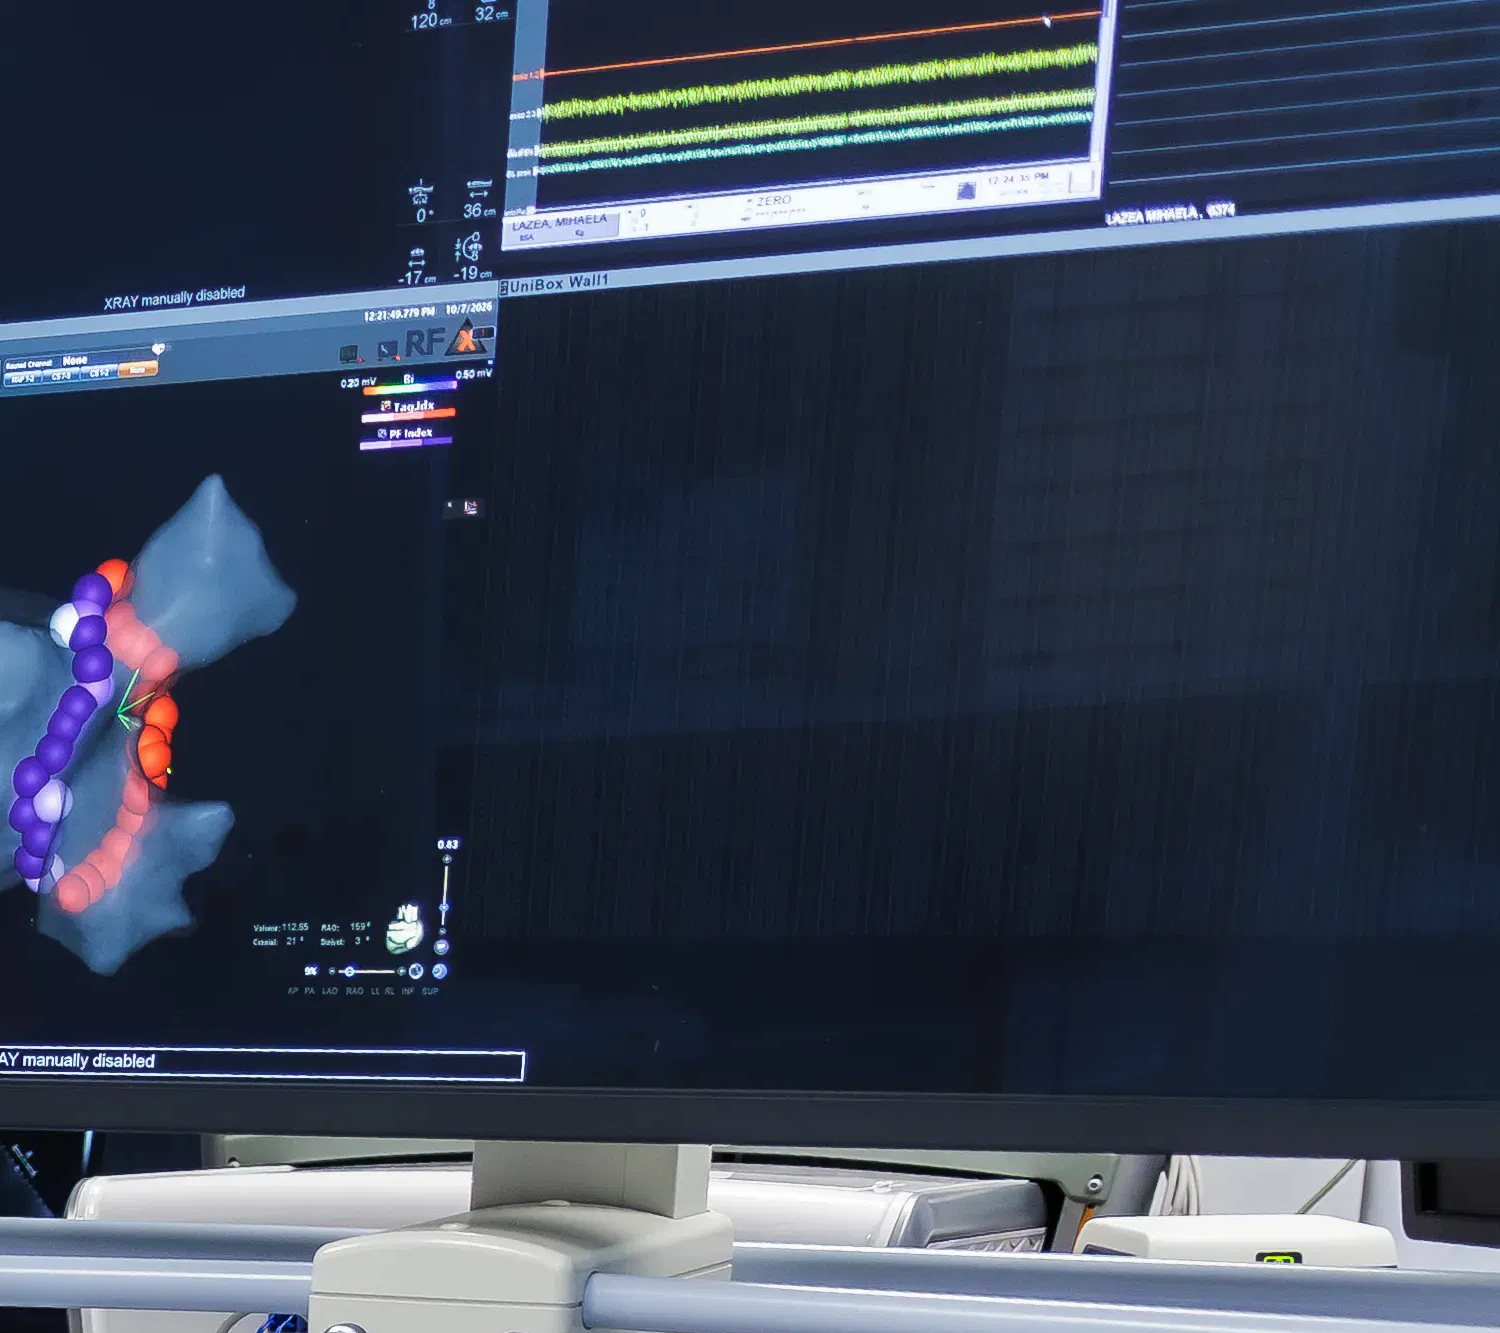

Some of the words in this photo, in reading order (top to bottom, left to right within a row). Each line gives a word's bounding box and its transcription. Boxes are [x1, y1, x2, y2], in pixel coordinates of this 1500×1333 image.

[411, 12, 438, 30] 120
[439, 18, 453, 26] cm
[475, 6, 494, 21] 32
[495, 11, 509, 20] cm
[757, 195, 792, 206] ZERO
[463, 203, 482, 218] 36
[484, 208, 497, 216] cm
[512, 219, 552, 231] LAZEA,
[555, 213, 608, 227] MIHAELA
[398, 271, 422, 285] -17
[453, 266, 478, 281] -19
[479, 271, 492, 279] cm
[510, 277, 563, 294] UniBox
[569, 273, 609, 289] Wall1
[104, 295, 139, 311] XRAY
[141, 291, 193, 309] manually
[195, 286, 246, 303] disabled
[405, 327, 447, 358] RF
[62, 355, 88, 367] None
[475, 368, 493, 379] mV
[360, 376, 377, 387] mV
[404, 426, 434, 438] Index
[22, 1052, 89, 1071] manually
[92, 1053, 155, 1070] disabled
